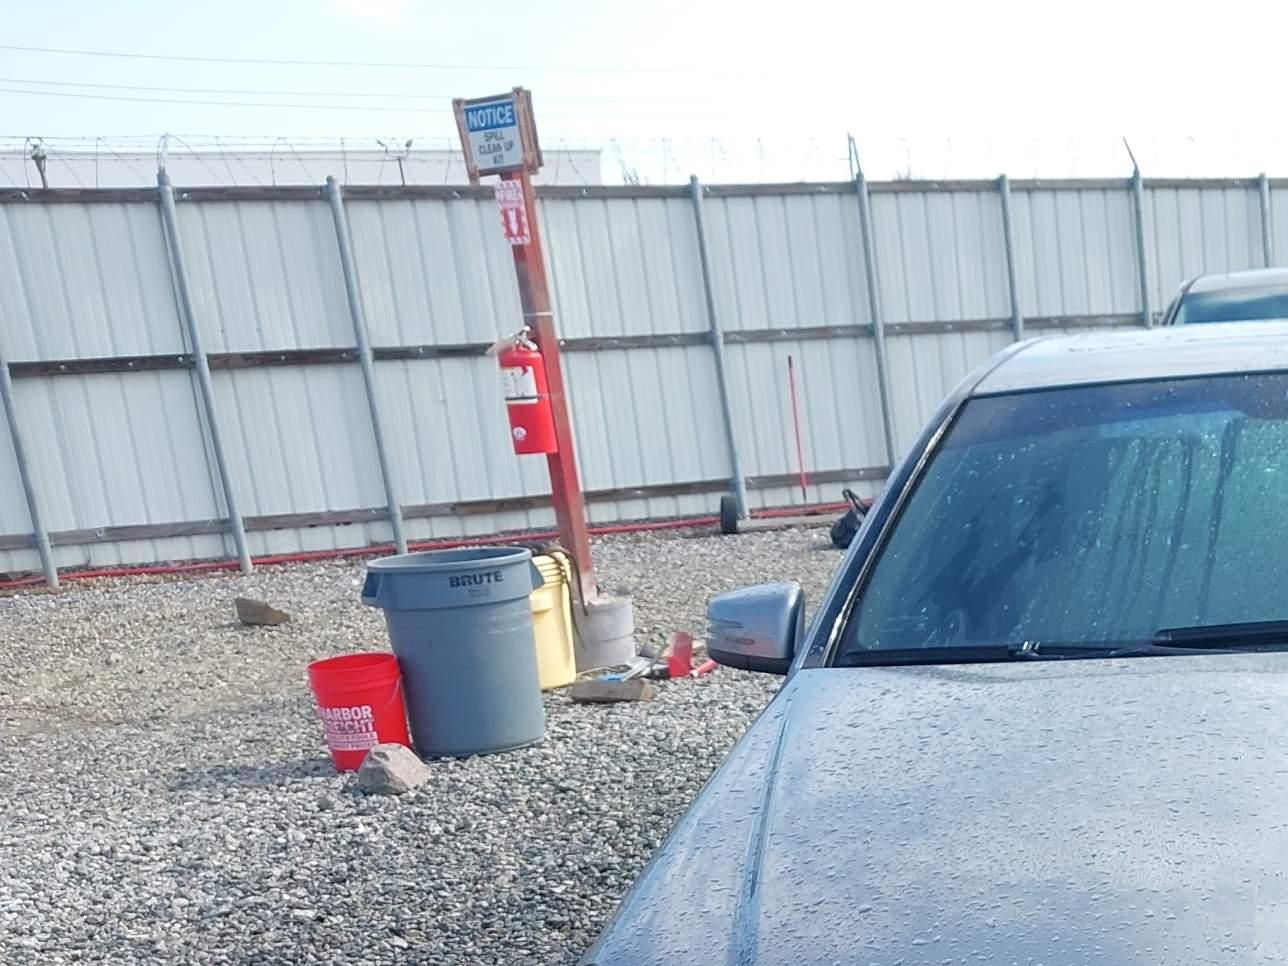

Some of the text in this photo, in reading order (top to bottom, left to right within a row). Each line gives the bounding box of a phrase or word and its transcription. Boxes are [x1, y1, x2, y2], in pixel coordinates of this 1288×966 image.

[468, 105, 514, 128] NOTICE
[484, 130, 505, 142] SPILL
[478, 140, 514, 155] CLEAN UP
[493, 154, 504, 164] KIT
[448, 571, 504, 588] BRUTE
